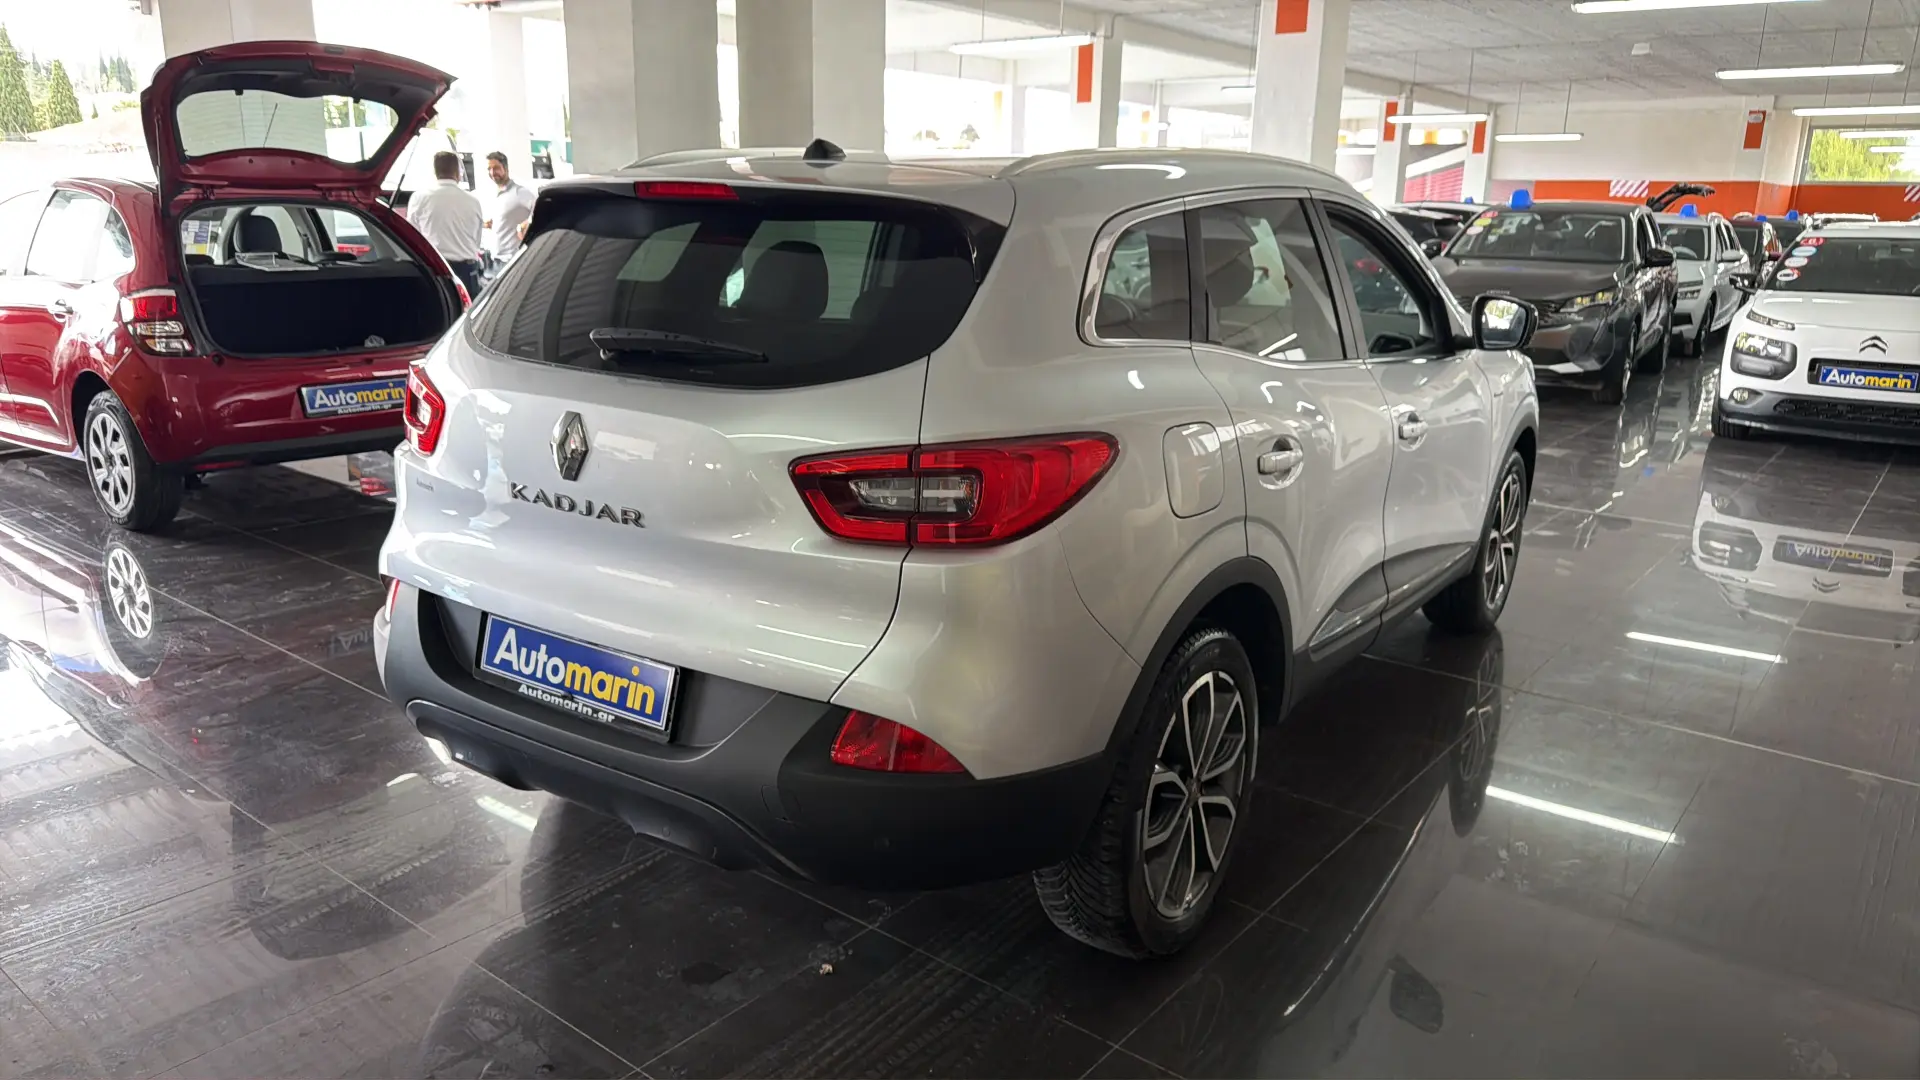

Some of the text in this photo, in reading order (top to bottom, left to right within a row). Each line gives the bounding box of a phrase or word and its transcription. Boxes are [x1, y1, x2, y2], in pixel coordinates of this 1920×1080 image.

[314, 382, 405, 408] Automarin
[1825, 368, 1912, 389] Automarin
[511, 482, 646, 528] KADJAR
[493, 627, 656, 714] Automarin
[518, 683, 616, 723] Automarin.gr
